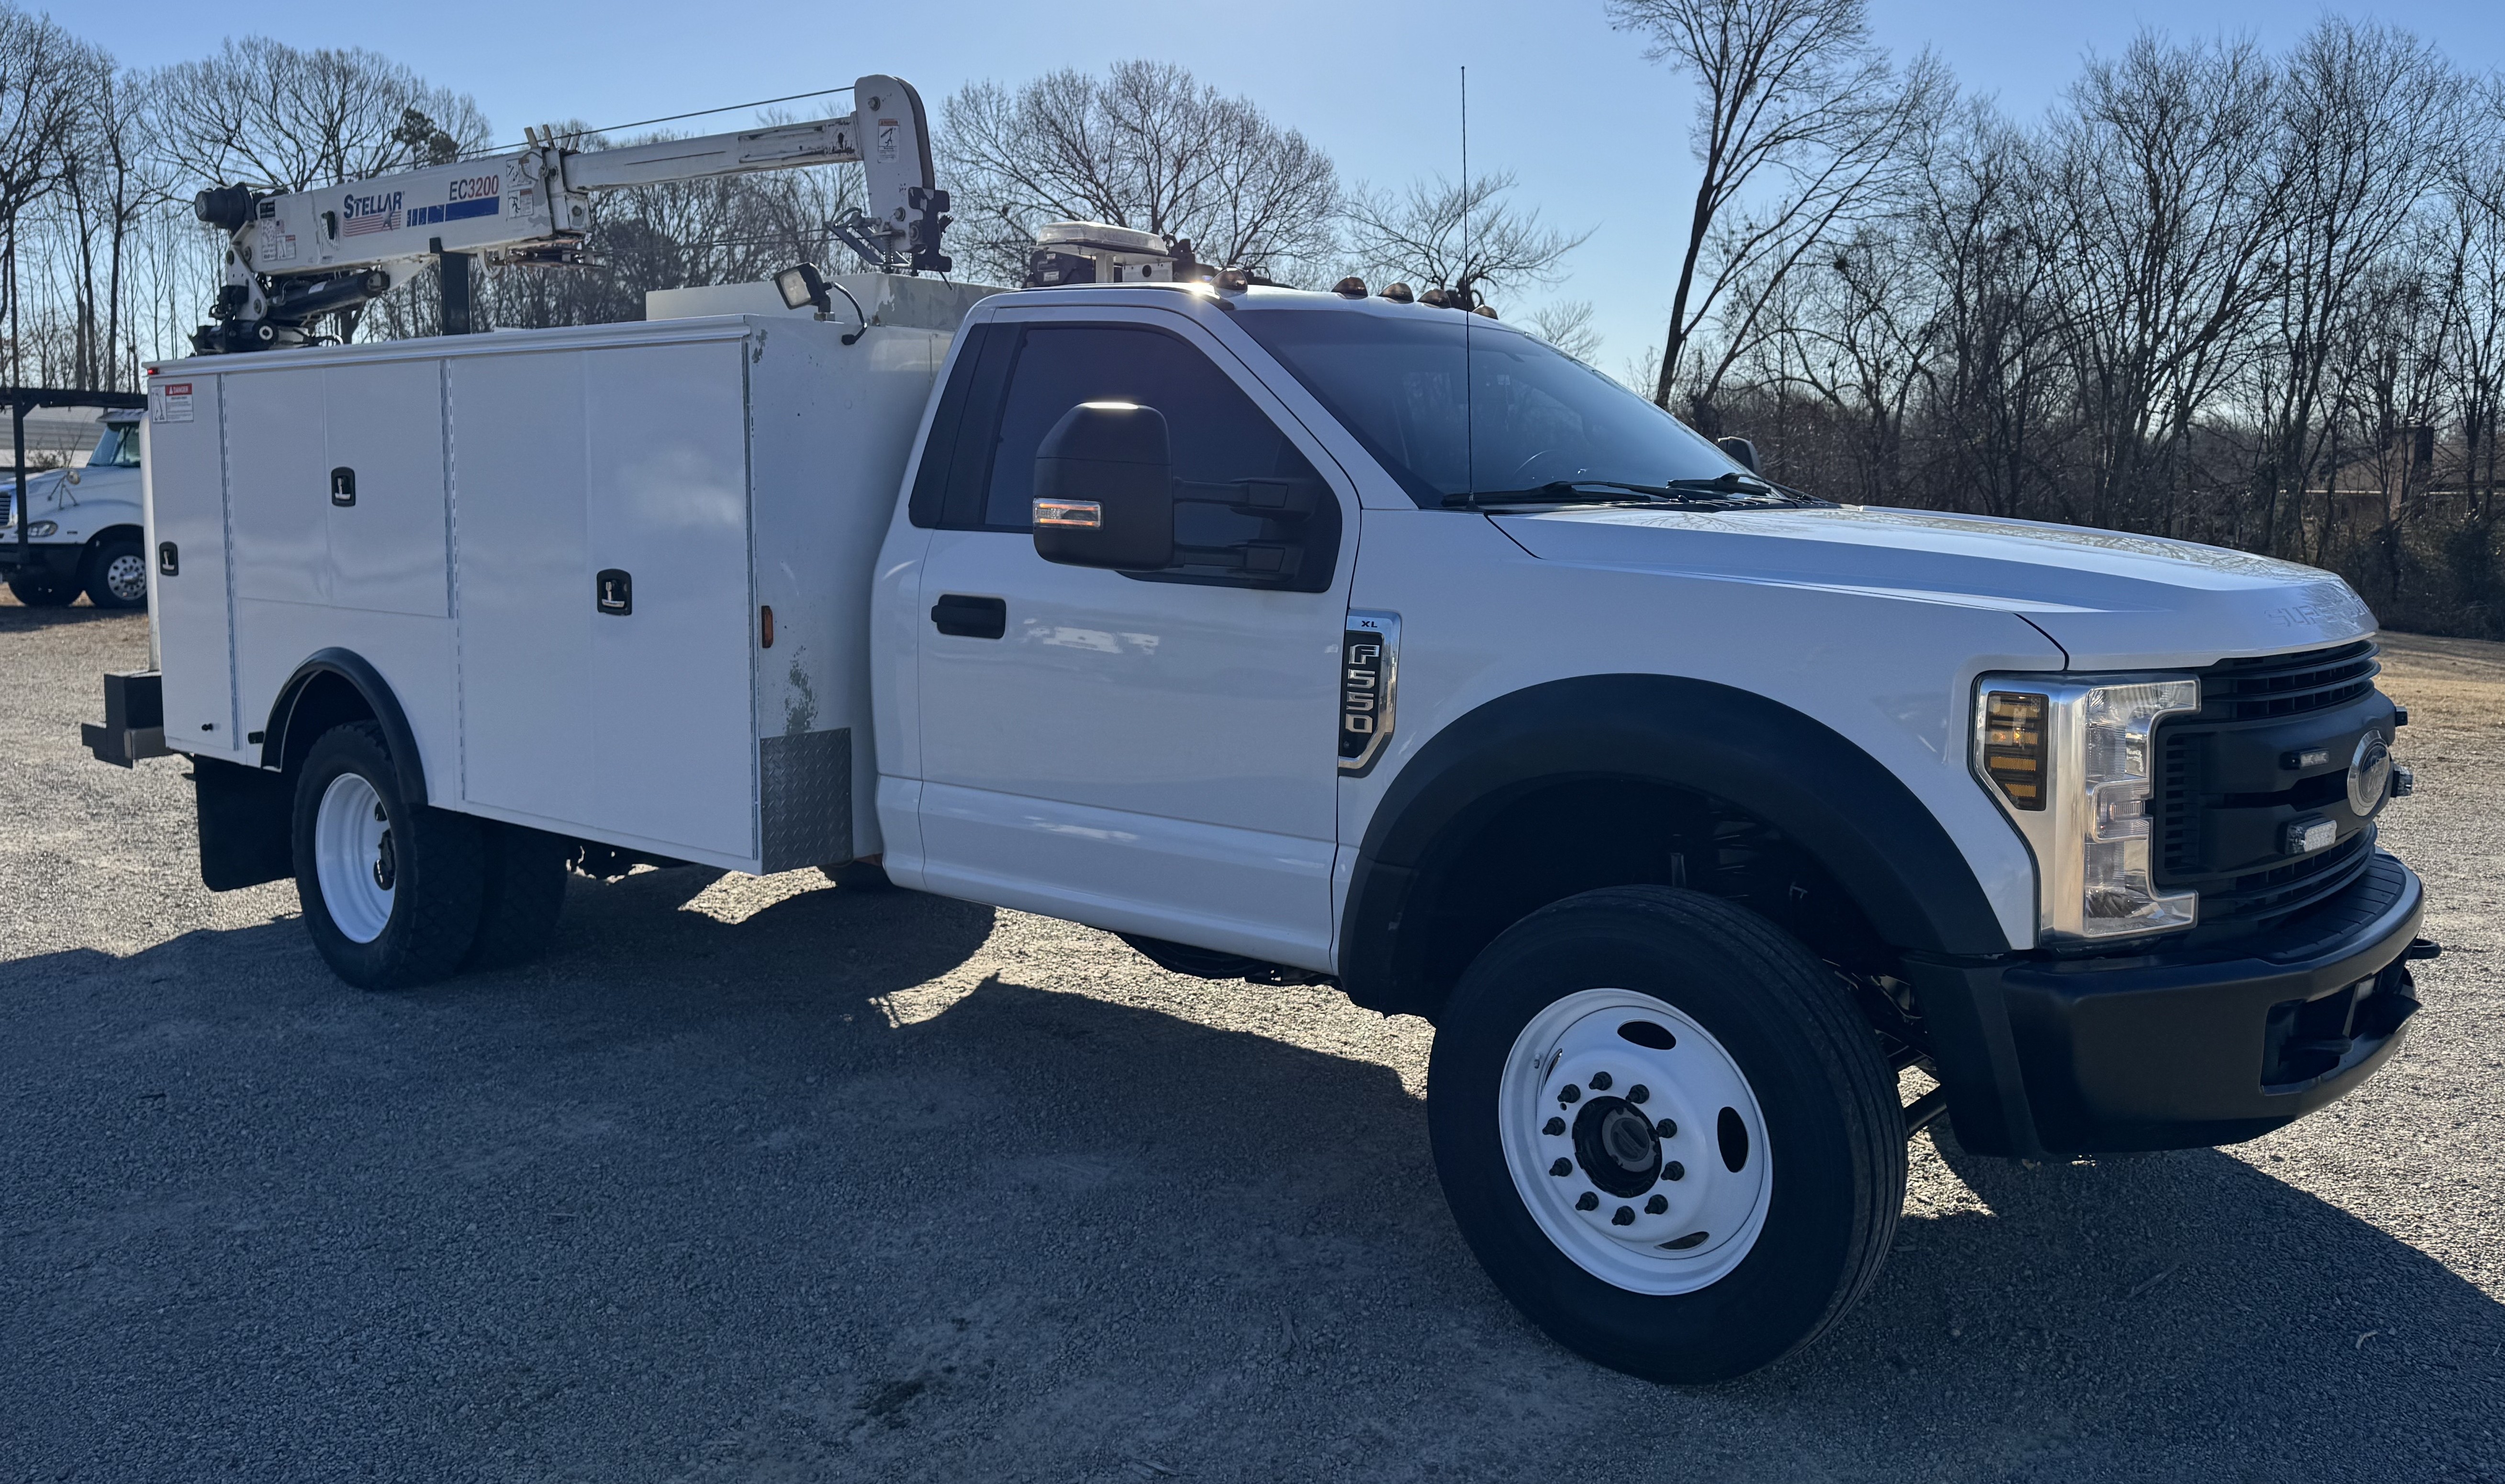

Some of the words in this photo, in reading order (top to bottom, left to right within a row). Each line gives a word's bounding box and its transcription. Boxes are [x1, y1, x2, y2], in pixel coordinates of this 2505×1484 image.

[449, 174, 499, 201] EC3200
[344, 191, 402, 219] STELLAR
[1345, 644, 1380, 733] F550
